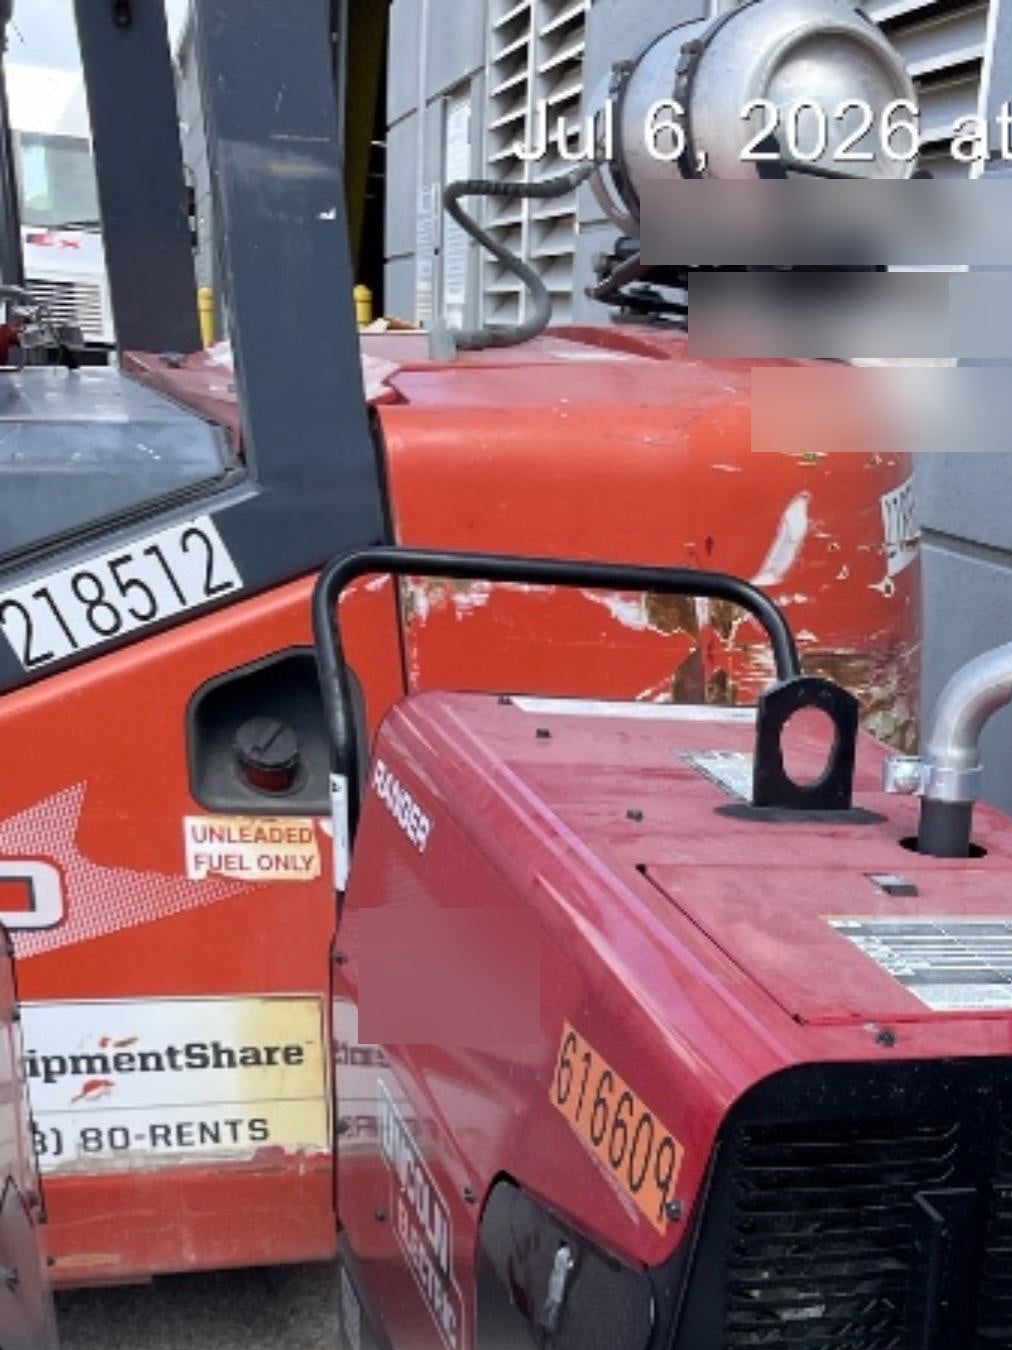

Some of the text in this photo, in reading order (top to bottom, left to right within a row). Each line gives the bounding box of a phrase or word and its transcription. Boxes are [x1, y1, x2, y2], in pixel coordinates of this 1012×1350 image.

[0, 528, 234, 666] 218512
[191, 824, 313, 844] UNLEADED
[371, 758, 434, 853] RANGER
[193, 853, 315, 871] FUEL ONLY
[80, 1118, 270, 1153] 80-RENTS
[556, 1031, 676, 1224] 616609
